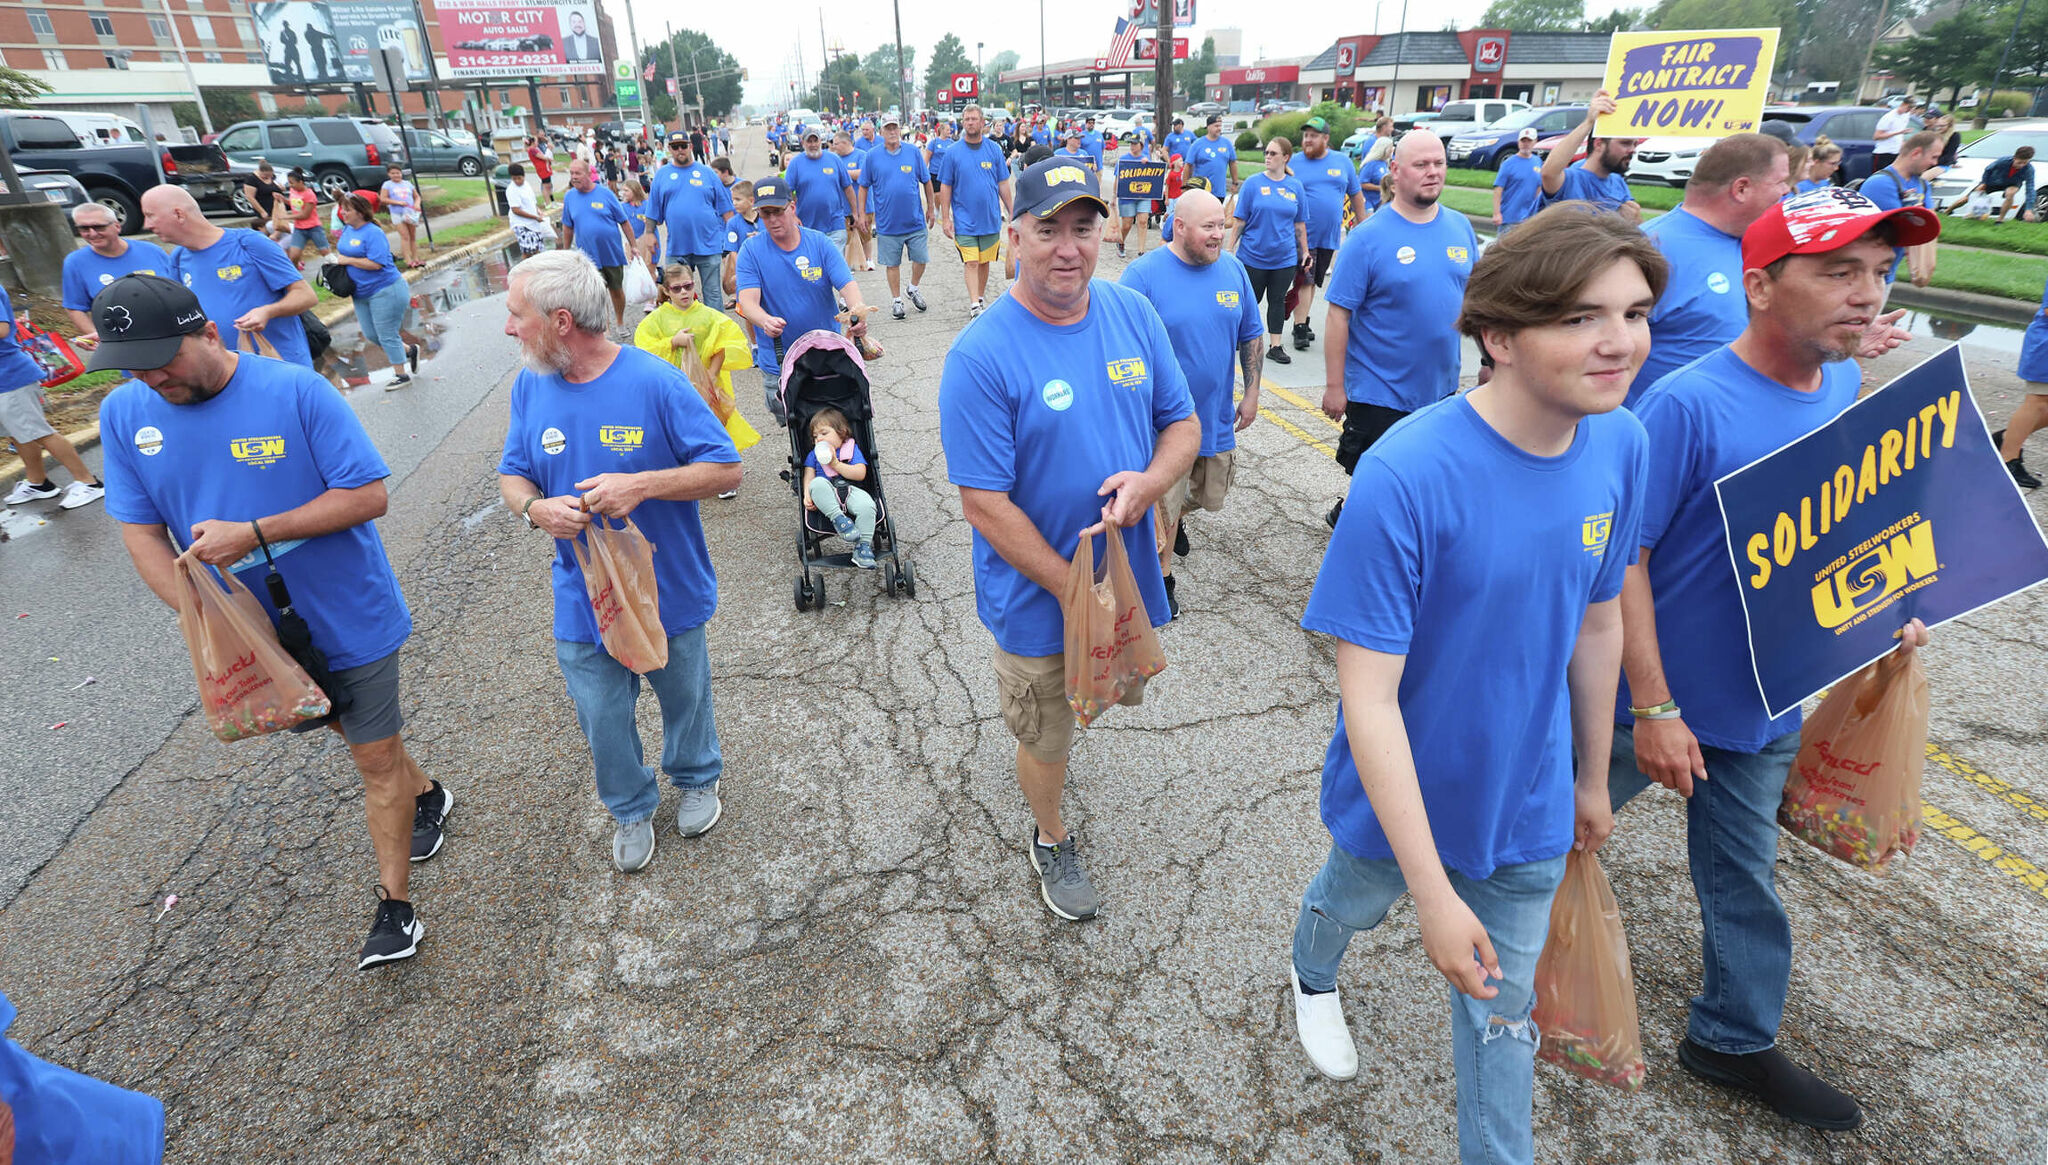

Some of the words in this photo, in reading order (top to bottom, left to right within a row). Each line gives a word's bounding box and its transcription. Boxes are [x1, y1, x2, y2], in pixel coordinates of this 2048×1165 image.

[514, 10, 544, 24] CITY
[483, 26, 505, 34] AUTO
[506, 25, 529, 34] SALES
[350, 37, 368, 50] 76
[1660, 42, 1716, 66] FAIR
[458, 54, 559, 67] 314-227-0231
[955, 76, 975, 94] QT
[1627, 64, 1747, 93] CONTRACT
[1630, 98, 1725, 129] NOW!
[1044, 165, 1087, 187] USW
[1119, 167, 1165, 179] SOLIDARITY
[1107, 360, 1147, 381] USW
[600, 429, 645, 445] USW
[230, 439, 286, 459] USW
[1747, 390, 1961, 590] SOLIDARITY
[1582, 518, 1613, 546] US
[1814, 555, 1848, 583] UNITED
[1848, 511, 1922, 561] STEELWORKERS
[1811, 519, 1939, 629] USW
[1834, 621, 1854, 636] UNITY
[1853, 613, 1868, 626] AND
[1893, 589, 1905, 602] FOR
[1904, 574, 1938, 595] WORKERS
